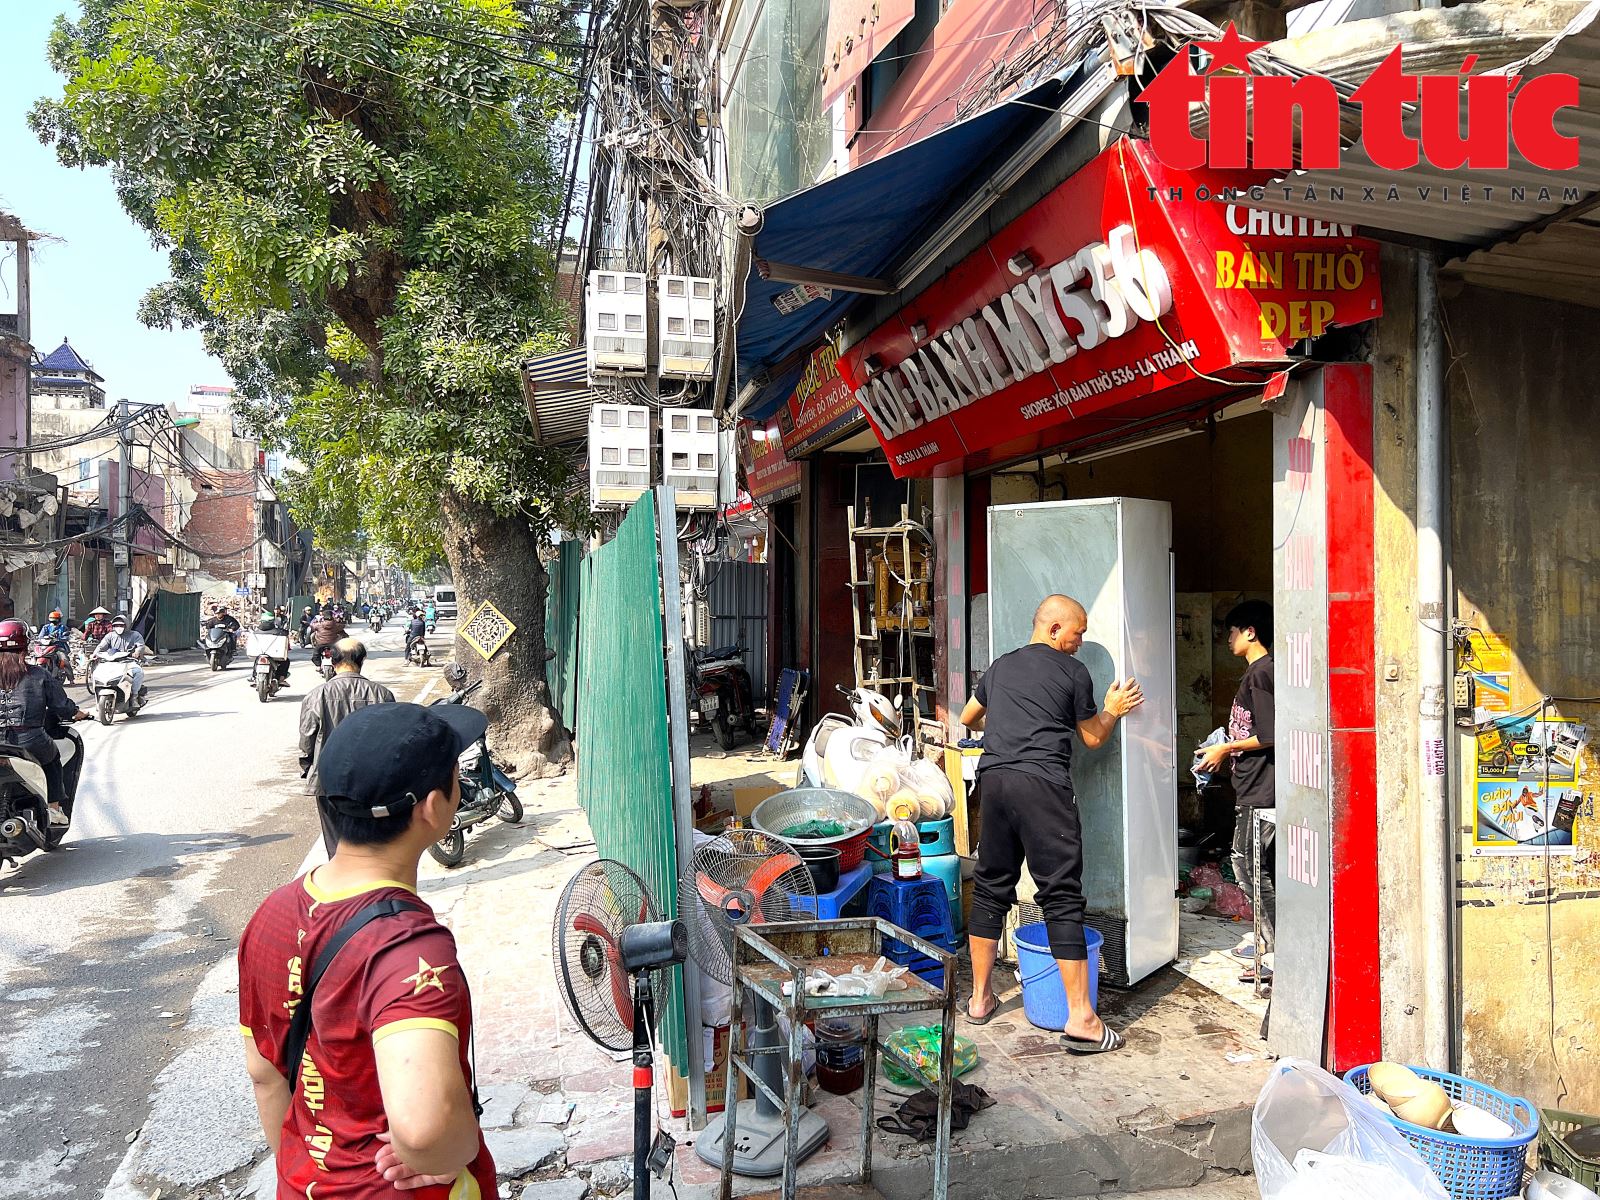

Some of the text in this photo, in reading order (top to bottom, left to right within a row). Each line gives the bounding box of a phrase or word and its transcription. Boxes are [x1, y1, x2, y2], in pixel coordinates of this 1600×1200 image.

[1050, 223, 1173, 350] 536
[1215, 242, 1365, 291] BÀN THỜ
[1020, 397, 1055, 420] SHOPEE:
[1052, 389, 1073, 409] XÔI
[1070, 381, 1093, 402] BÀN
[1089, 370, 1113, 395] THỜ
[1112, 365, 1136, 386] 536
[1152, 339, 1201, 370] THÀNH
